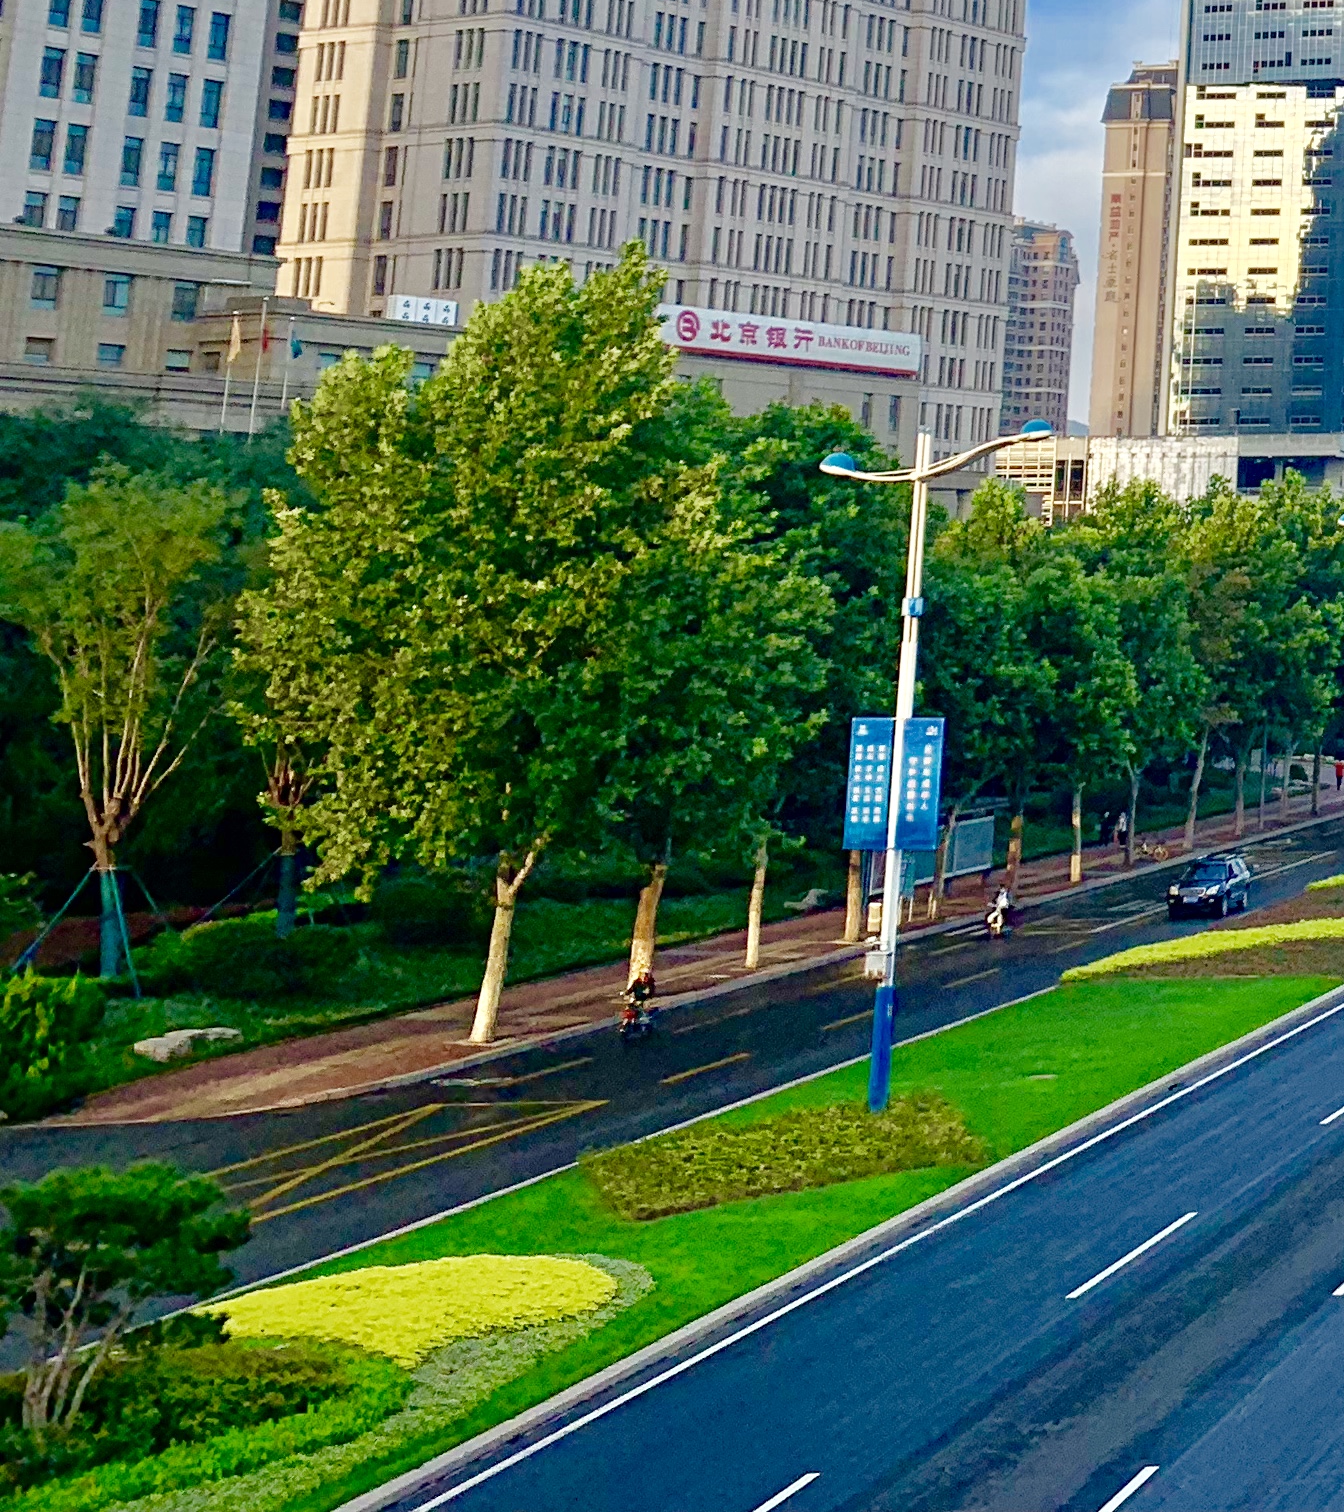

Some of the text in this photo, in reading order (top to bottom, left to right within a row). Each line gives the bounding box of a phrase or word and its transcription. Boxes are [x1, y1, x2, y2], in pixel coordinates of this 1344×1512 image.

[709, 318, 815, 353] 北京银行
[818, 335, 911, 356] BANK OF BEIJING
